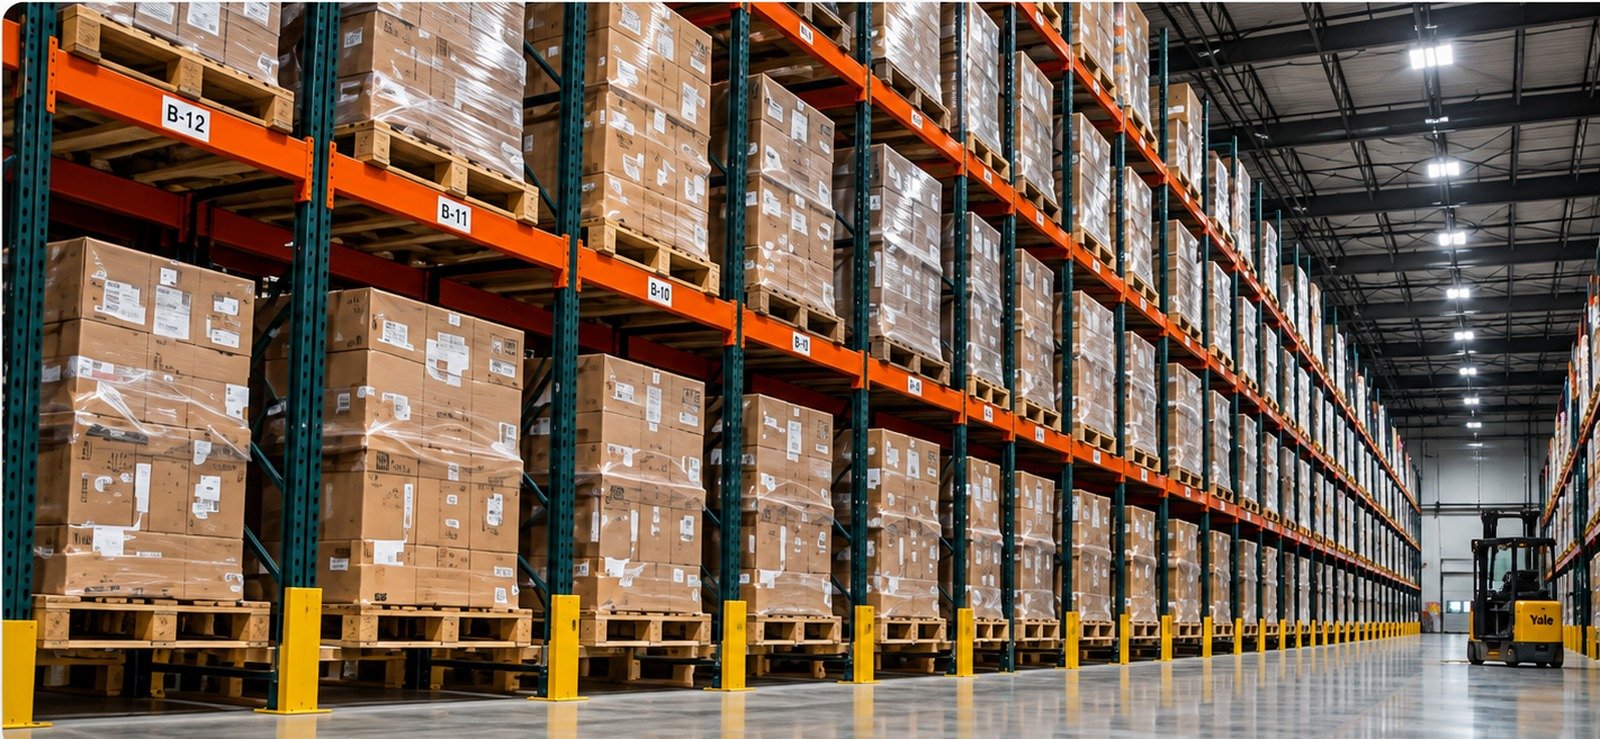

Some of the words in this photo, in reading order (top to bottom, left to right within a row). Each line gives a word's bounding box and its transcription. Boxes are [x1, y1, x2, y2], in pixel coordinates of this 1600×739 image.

[167, 103, 205, 133] B-12
[442, 203, 467, 227] B-11
[651, 282, 670, 301] B-10
[1529, 613, 1554, 626] Yale
